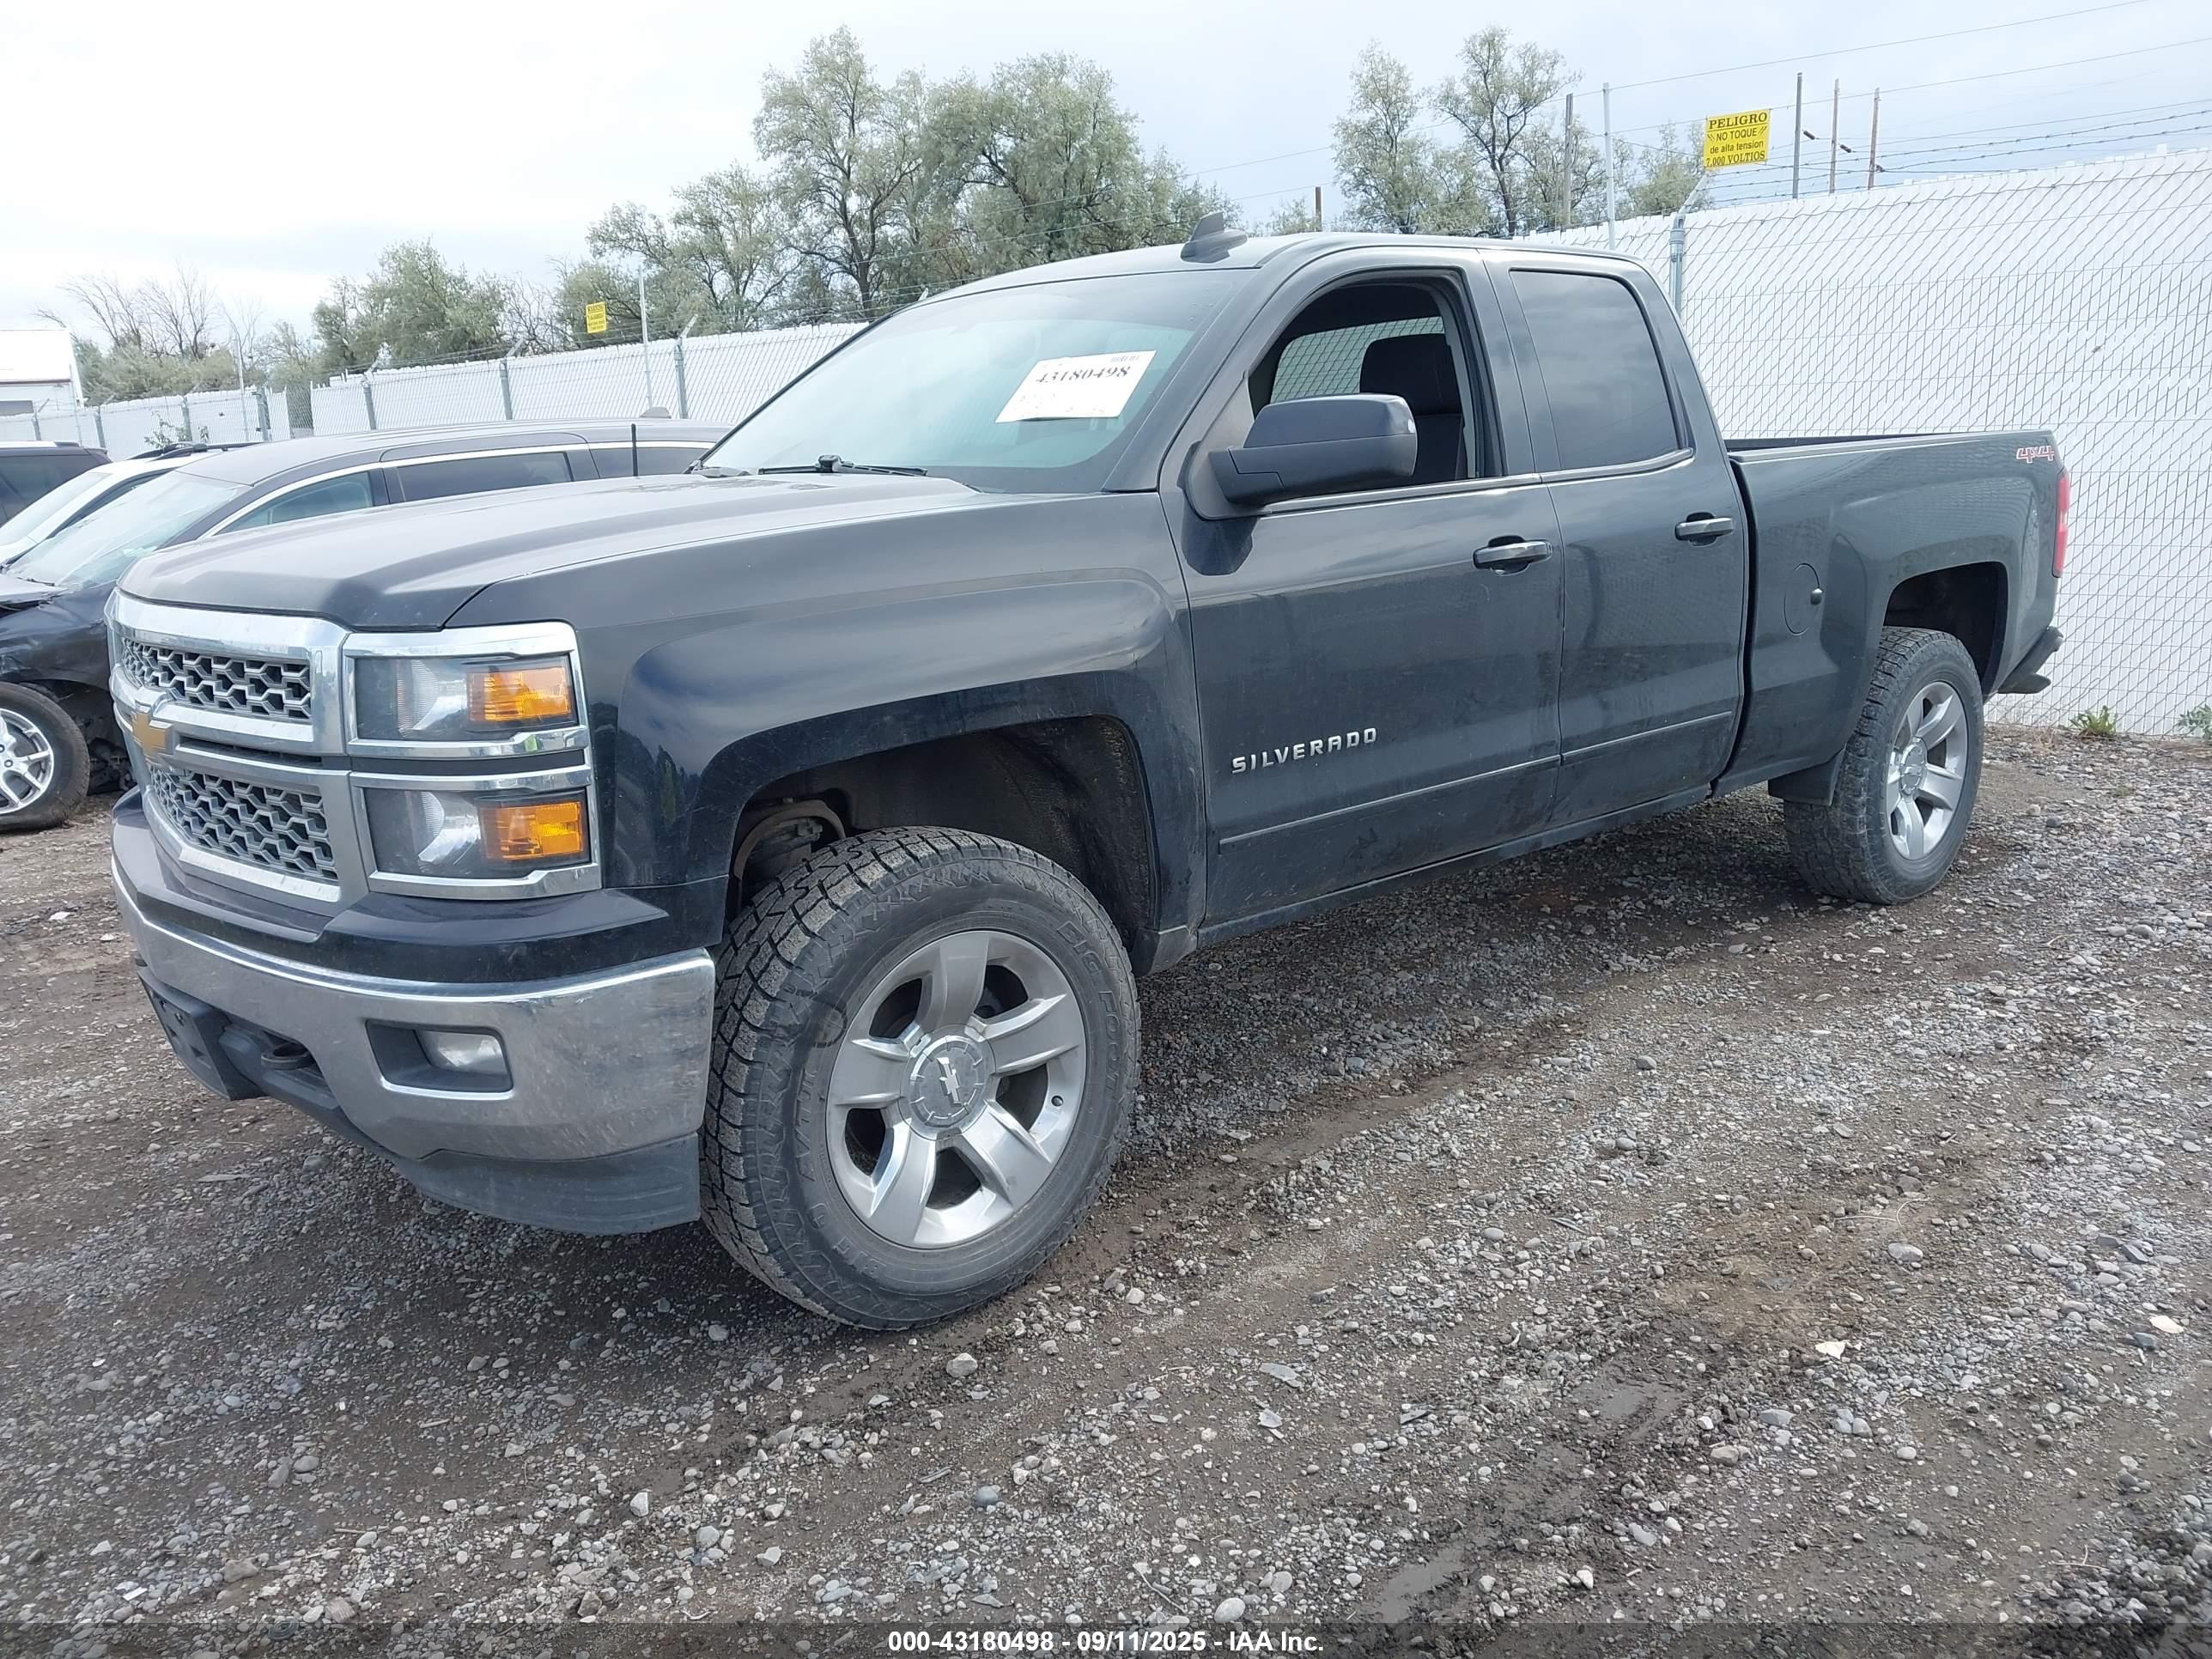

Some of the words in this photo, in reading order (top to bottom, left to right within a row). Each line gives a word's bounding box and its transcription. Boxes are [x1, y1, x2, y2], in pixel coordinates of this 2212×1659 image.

[1709, 112, 1767, 130] PELIGRO
[1717, 131, 1728, 141] NO
[1730, 127, 1757, 140] TOQUE
[1711, 145, 1719, 154] de
[1721, 143, 1734, 153] alta
[1728, 150, 1765, 164] VOLTIOS
[1036, 366, 1131, 383] 43180498
[1231, 727, 1377, 775] SILVERADO
[1056, 921, 1102, 975] BIG
